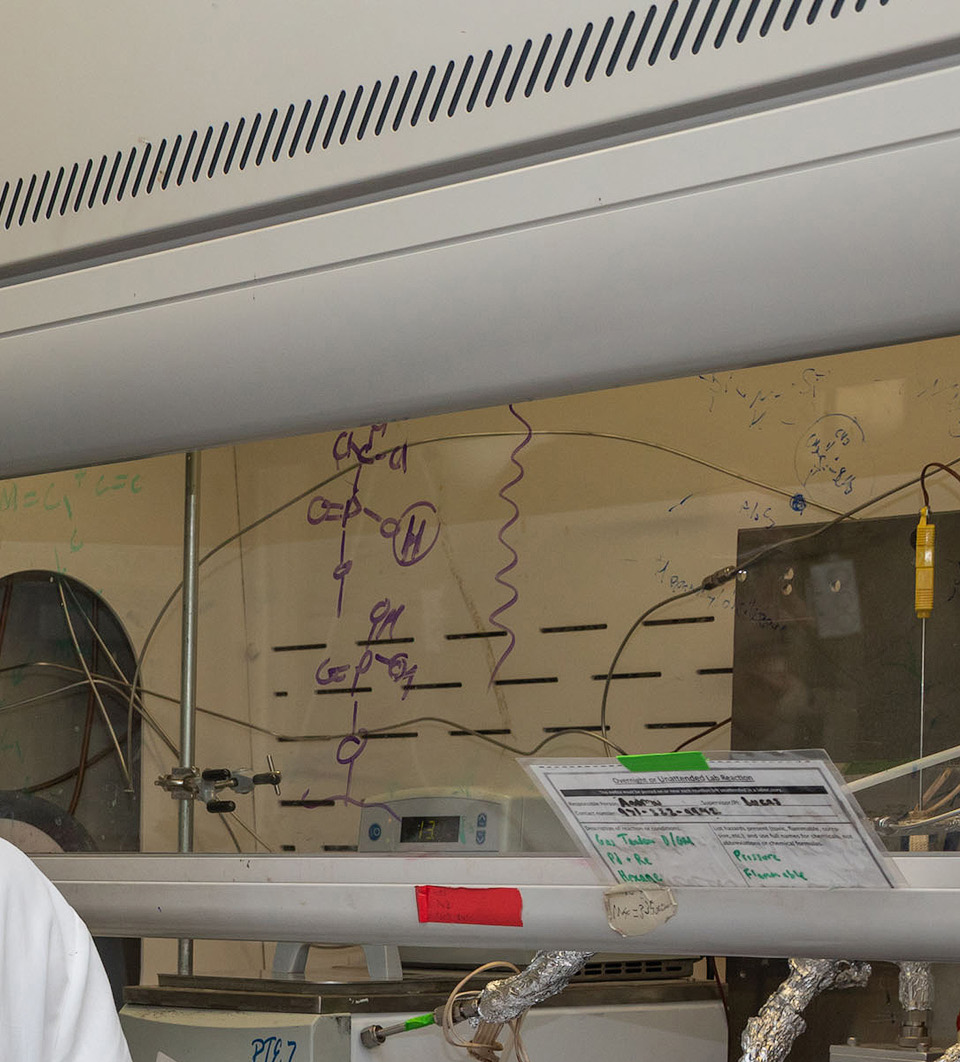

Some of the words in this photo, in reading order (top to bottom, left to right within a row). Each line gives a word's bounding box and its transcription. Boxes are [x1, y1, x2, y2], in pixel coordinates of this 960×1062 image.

[657, 775, 705, 783] Unattended
[706, 774, 720, 782] Lab
[720, 774, 754, 782] Reaction
